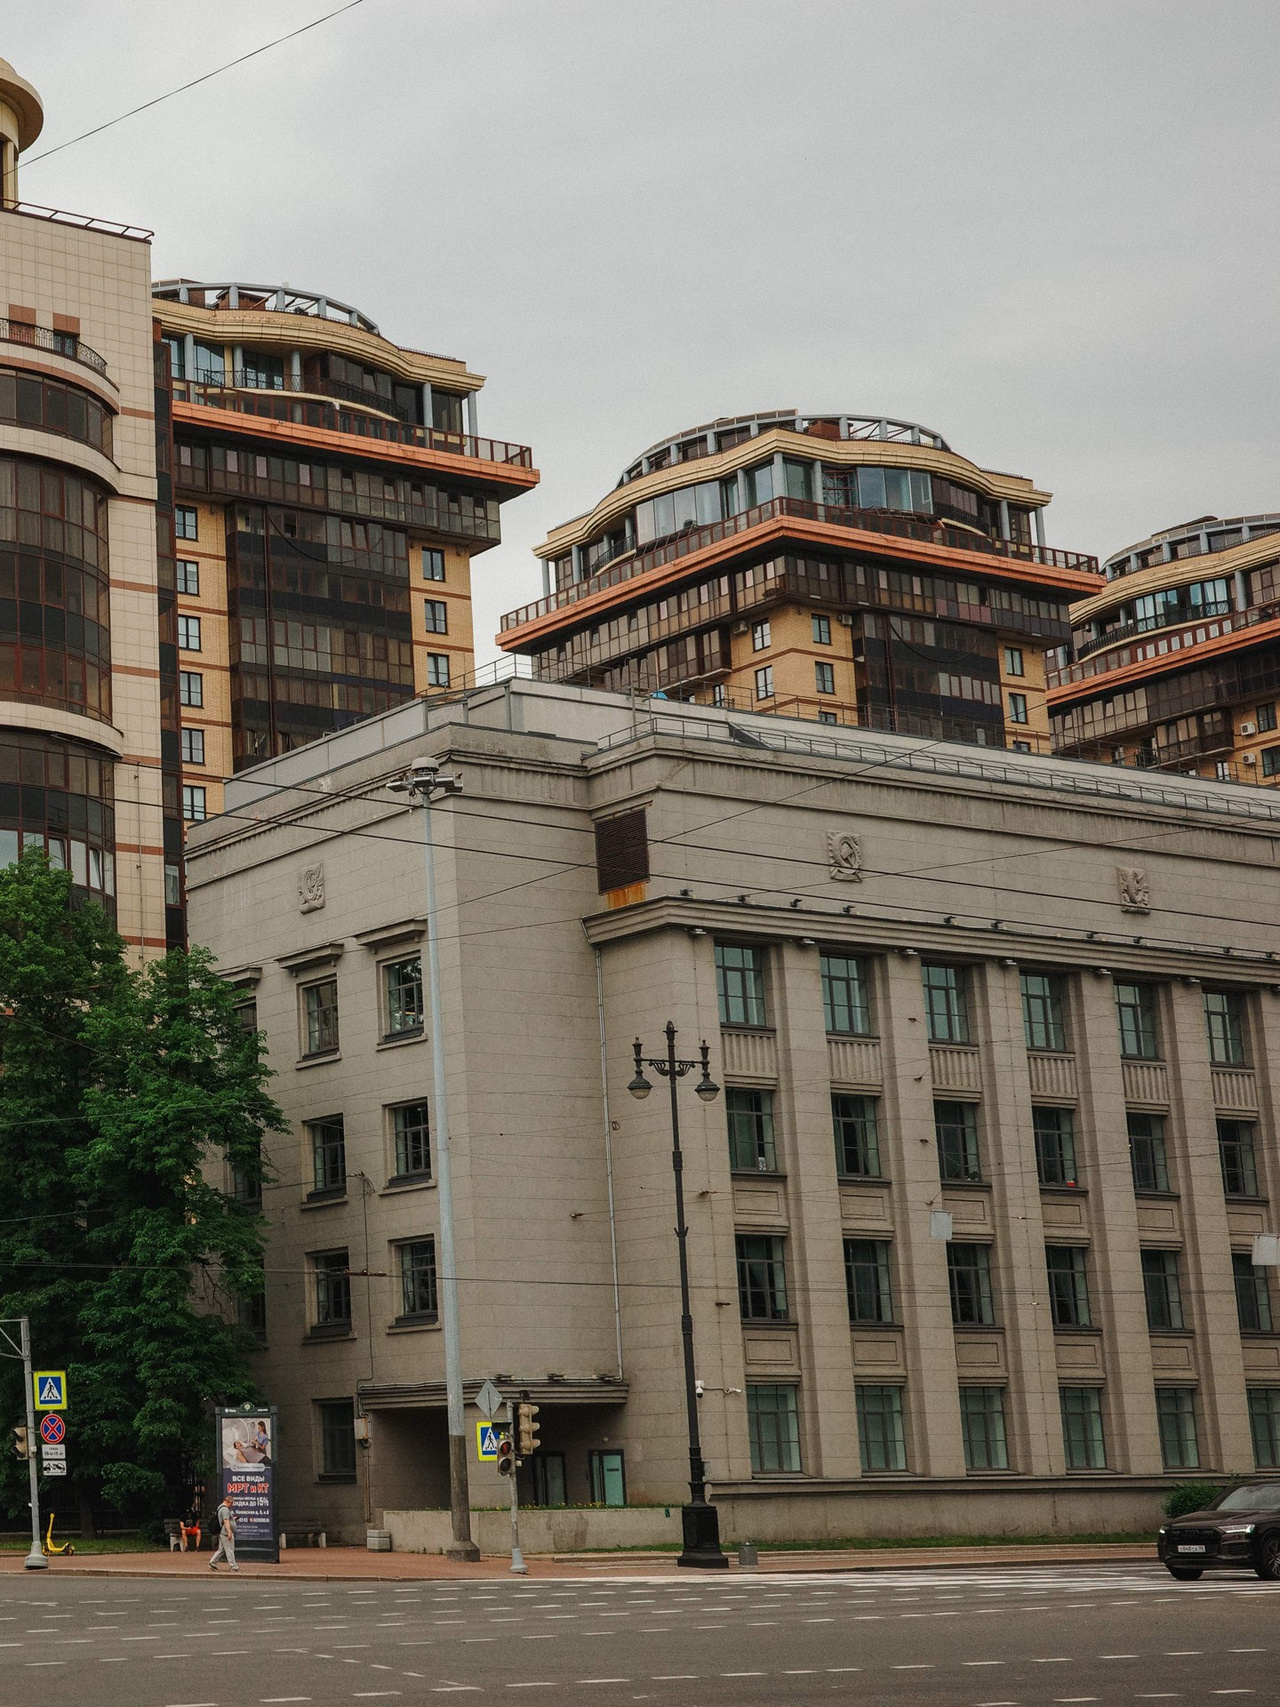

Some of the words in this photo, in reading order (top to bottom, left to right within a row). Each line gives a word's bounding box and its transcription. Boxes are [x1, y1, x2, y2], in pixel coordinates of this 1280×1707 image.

[246, 1475, 265, 1483] ВИДЫ
[227, 1483, 249, 1493] МРТ
[257, 1483, 269, 1493] КТ
